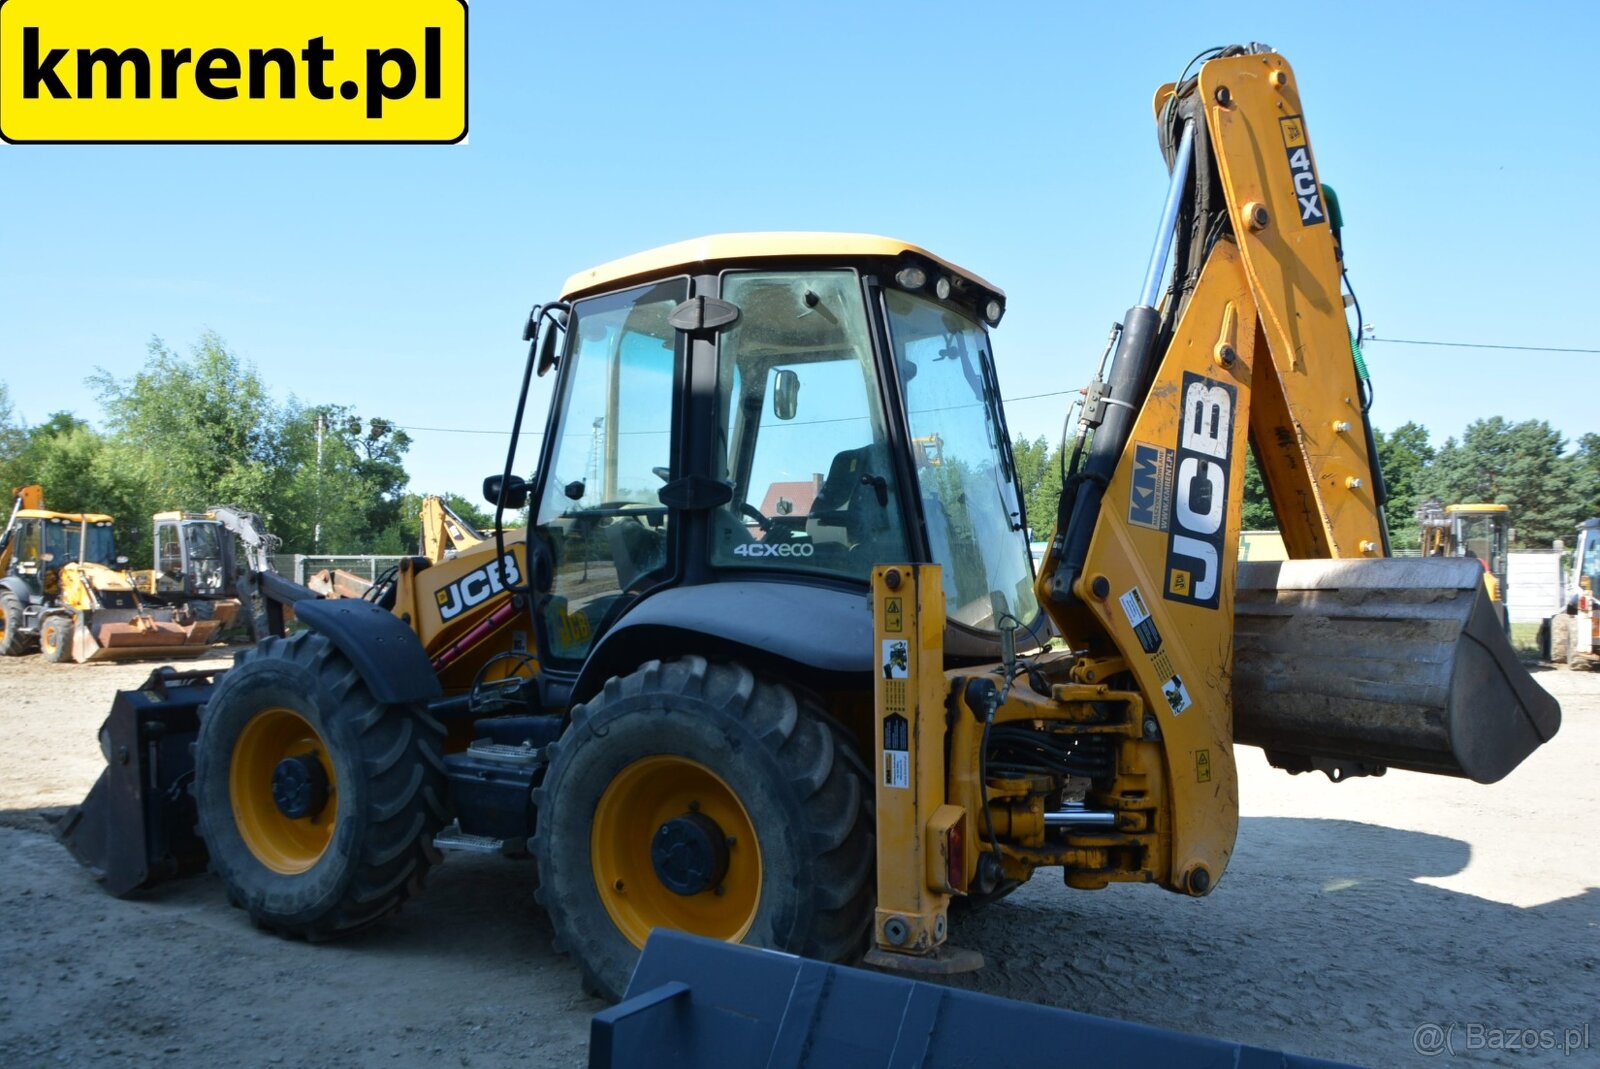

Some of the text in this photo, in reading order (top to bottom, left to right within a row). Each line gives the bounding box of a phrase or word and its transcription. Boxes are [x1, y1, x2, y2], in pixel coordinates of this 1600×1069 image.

[1290, 148, 1323, 220] 4CX
[1131, 445, 1159, 524] KM
[1161, 451, 1174, 529] WWW.KMRENT.PL
[1173, 381, 1231, 601] JCB
[440, 554, 520, 620] JCB
